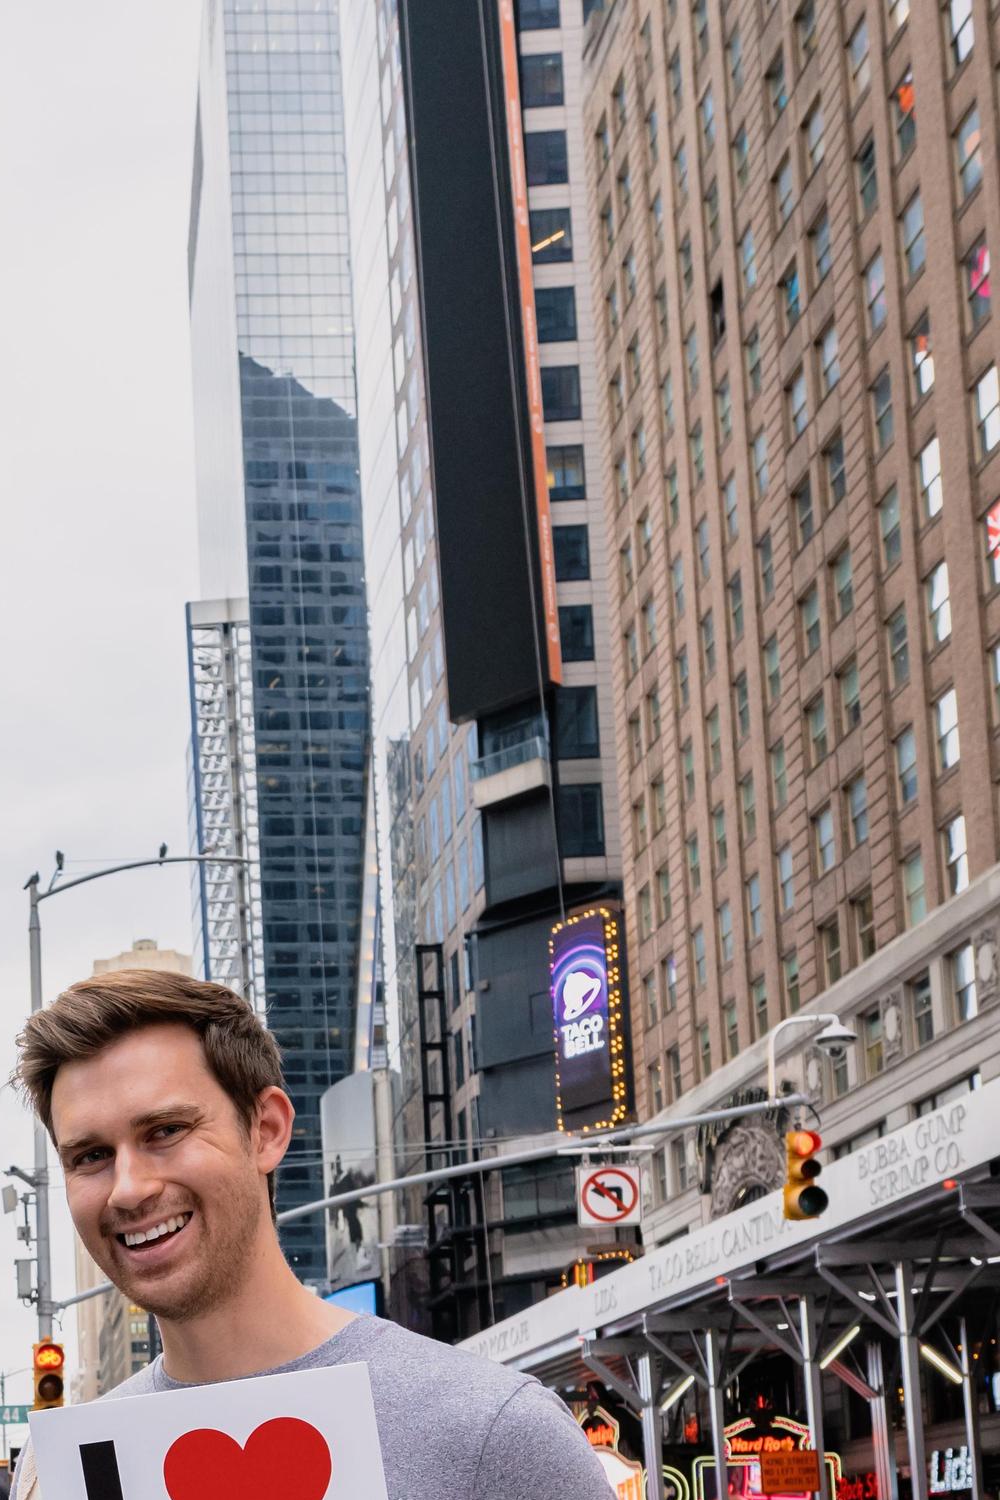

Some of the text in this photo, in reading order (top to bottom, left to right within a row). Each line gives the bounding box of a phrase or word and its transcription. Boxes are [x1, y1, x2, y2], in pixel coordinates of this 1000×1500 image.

[561, 1014, 604, 1042] TACO
[564, 1032, 605, 1059] BELL
[915, 1103, 967, 1151] GUMP
[3, 1407, 19, 1422] 44
[731, 1437, 763, 1453] Hard
